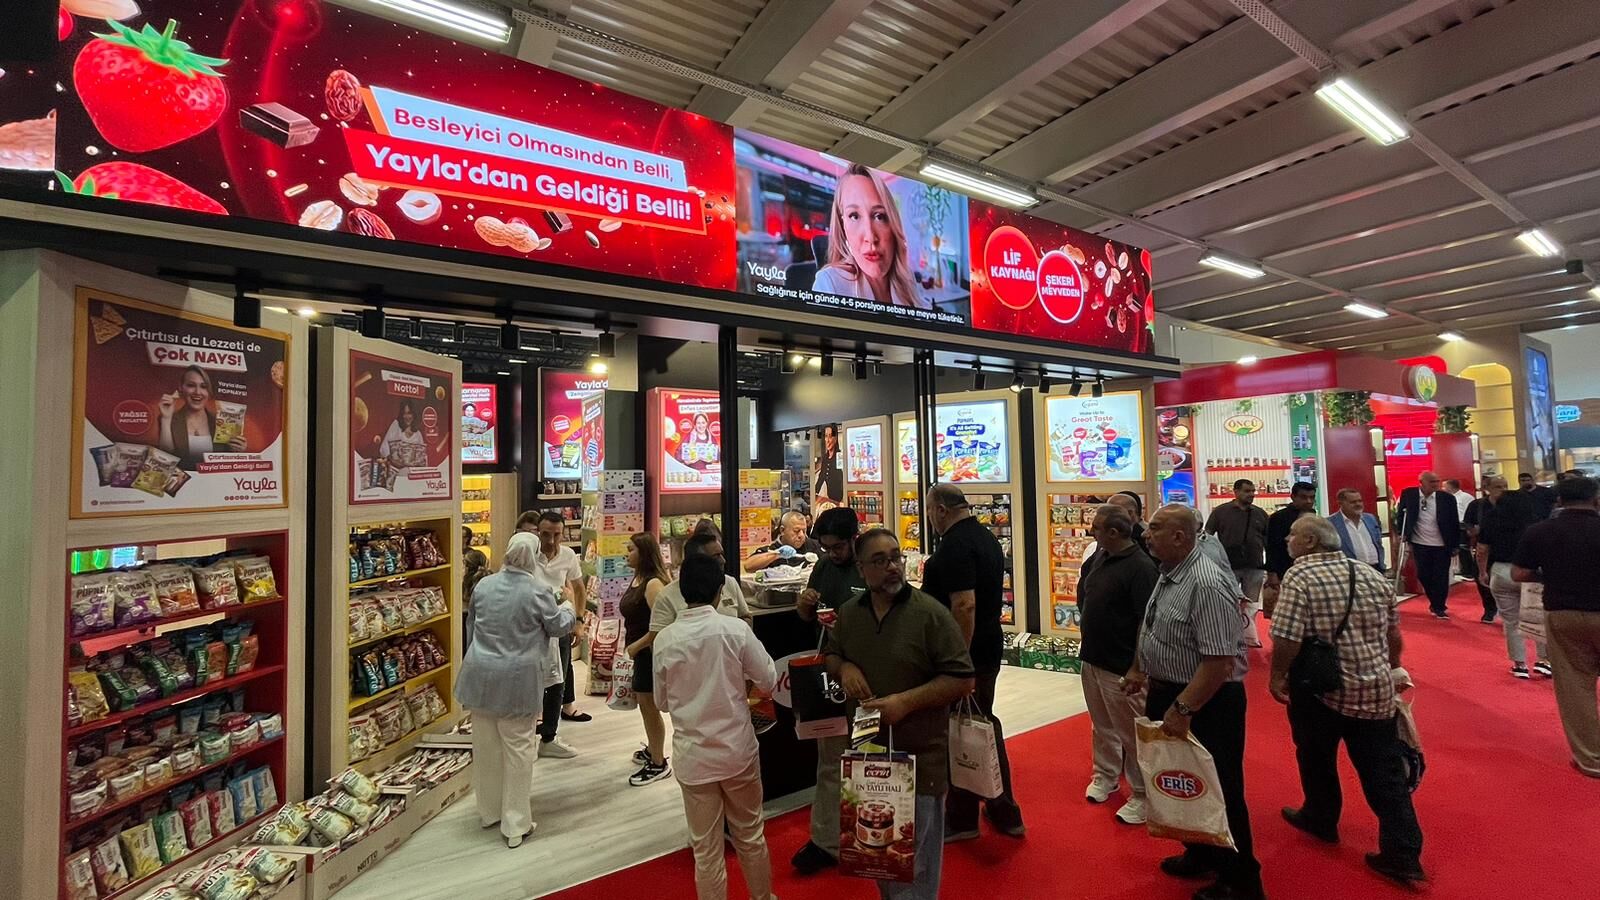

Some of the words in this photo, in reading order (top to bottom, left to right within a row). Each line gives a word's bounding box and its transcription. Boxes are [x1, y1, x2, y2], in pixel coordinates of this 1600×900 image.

[394, 108, 501, 144] Besleyici
[507, 132, 628, 171] Olmasından
[633, 160, 674, 183] Belli,
[366, 143, 528, 192] Yayla'dan
[535, 175, 629, 214] Geldiği
[636, 193, 691, 221] Belli!
[1003, 248, 1021, 266] LİF
[747, 261, 787, 281] Yayla
[990, 266, 1036, 281] KAYNAĞI
[1045, 274, 1075, 288] ŞEKERİ
[1041, 286, 1081, 297] MEYVEDEN
[756, 283, 798, 298] Sağlığınız
[798, 290, 814, 301] için
[814, 294, 840, 304] günde
[840, 297, 854, 307] 4-5
[855, 301, 886, 312] porsiyon
[886, 305, 907, 315] sebze
[916, 310, 937, 320] meyve
[126, 328, 179, 343] Çıtırtısı
[181, 334, 199, 345] da
[202, 336, 245, 351] Lezzeti
[246, 343, 261, 353] de
[154, 346, 189, 363] Çok
[194, 351, 242, 366] NAYS!
[233, 477, 278, 493] Yayla
[426, 480, 447, 491] Yayla
